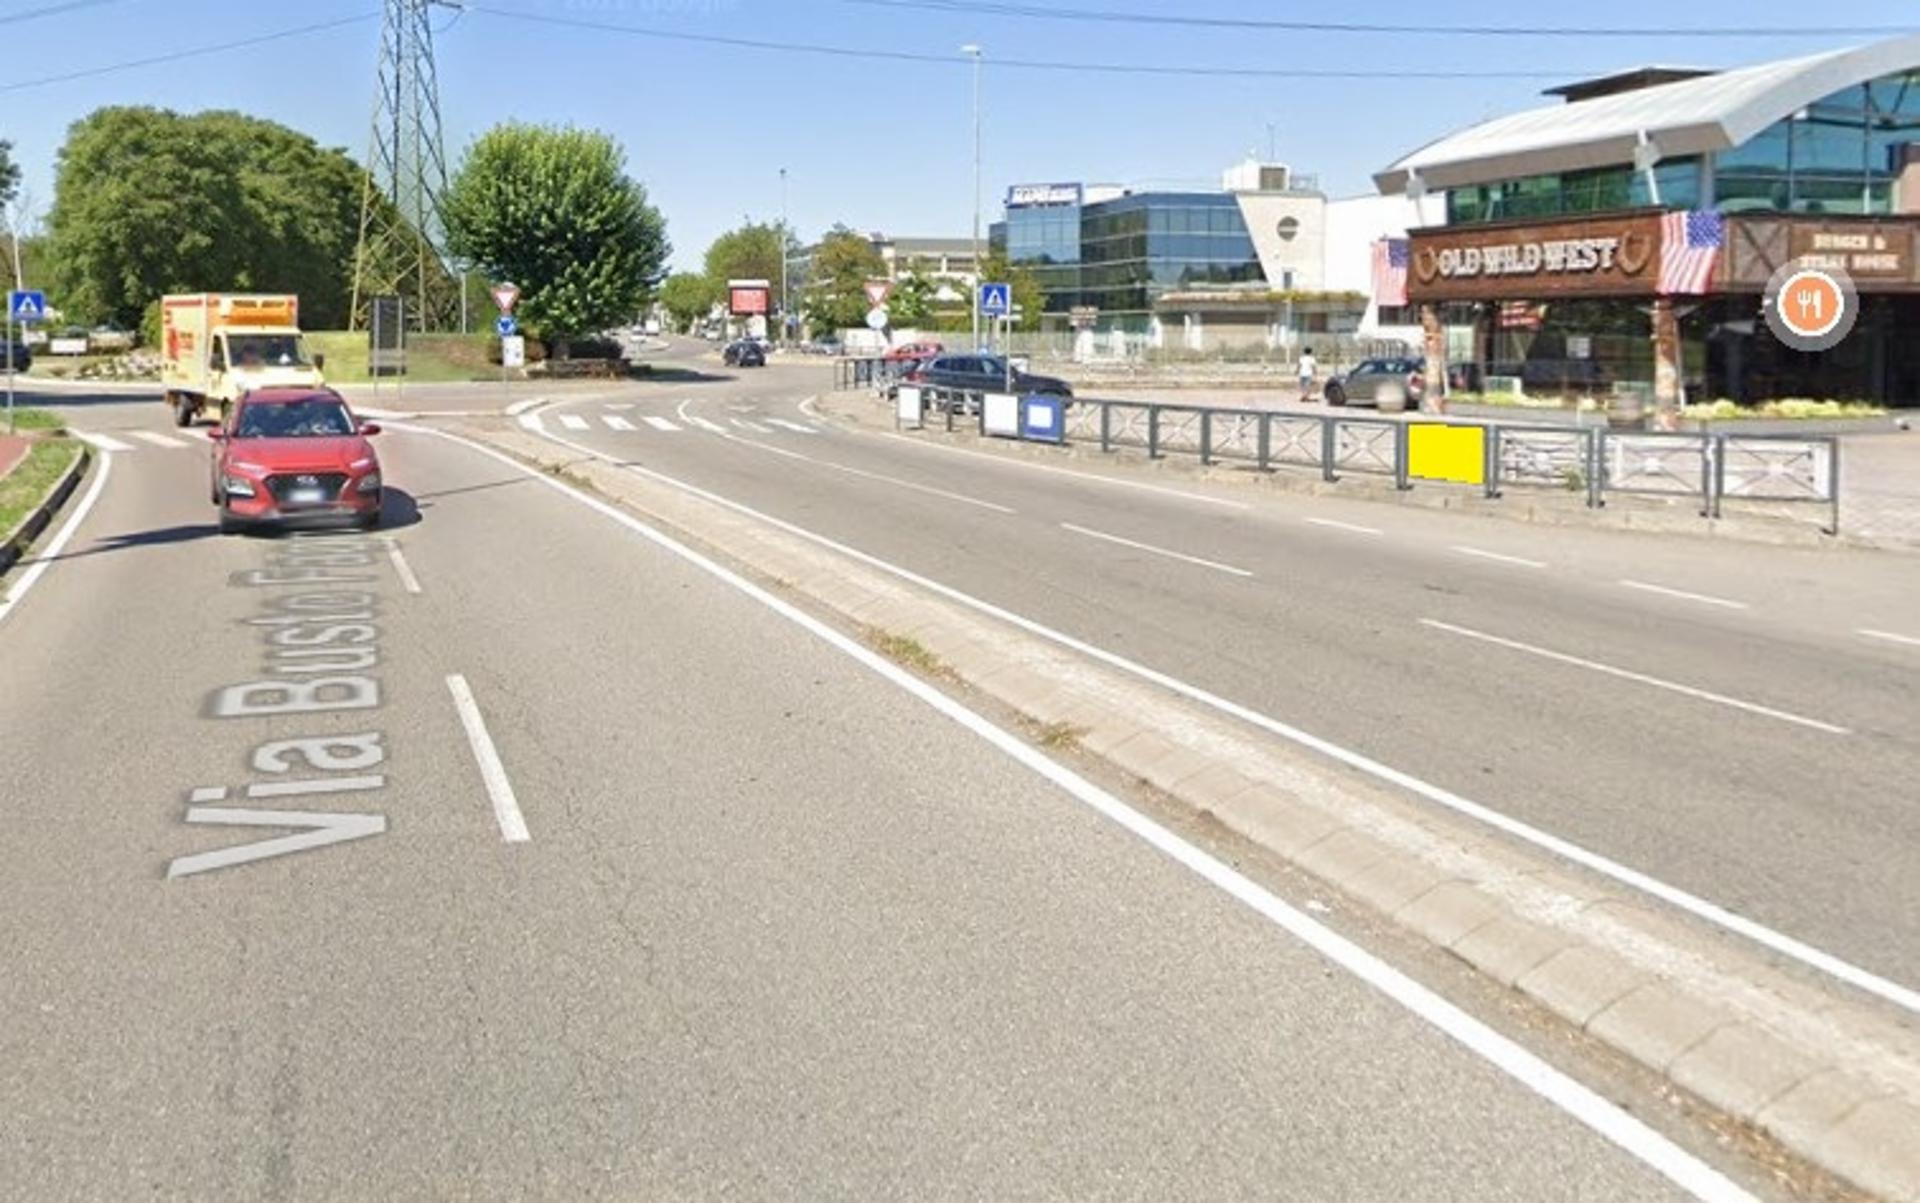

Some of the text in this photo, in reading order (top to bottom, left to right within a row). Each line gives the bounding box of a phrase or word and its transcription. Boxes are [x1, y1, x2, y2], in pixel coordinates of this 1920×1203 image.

[1438, 238, 1618, 277] OLD WILD WEST
